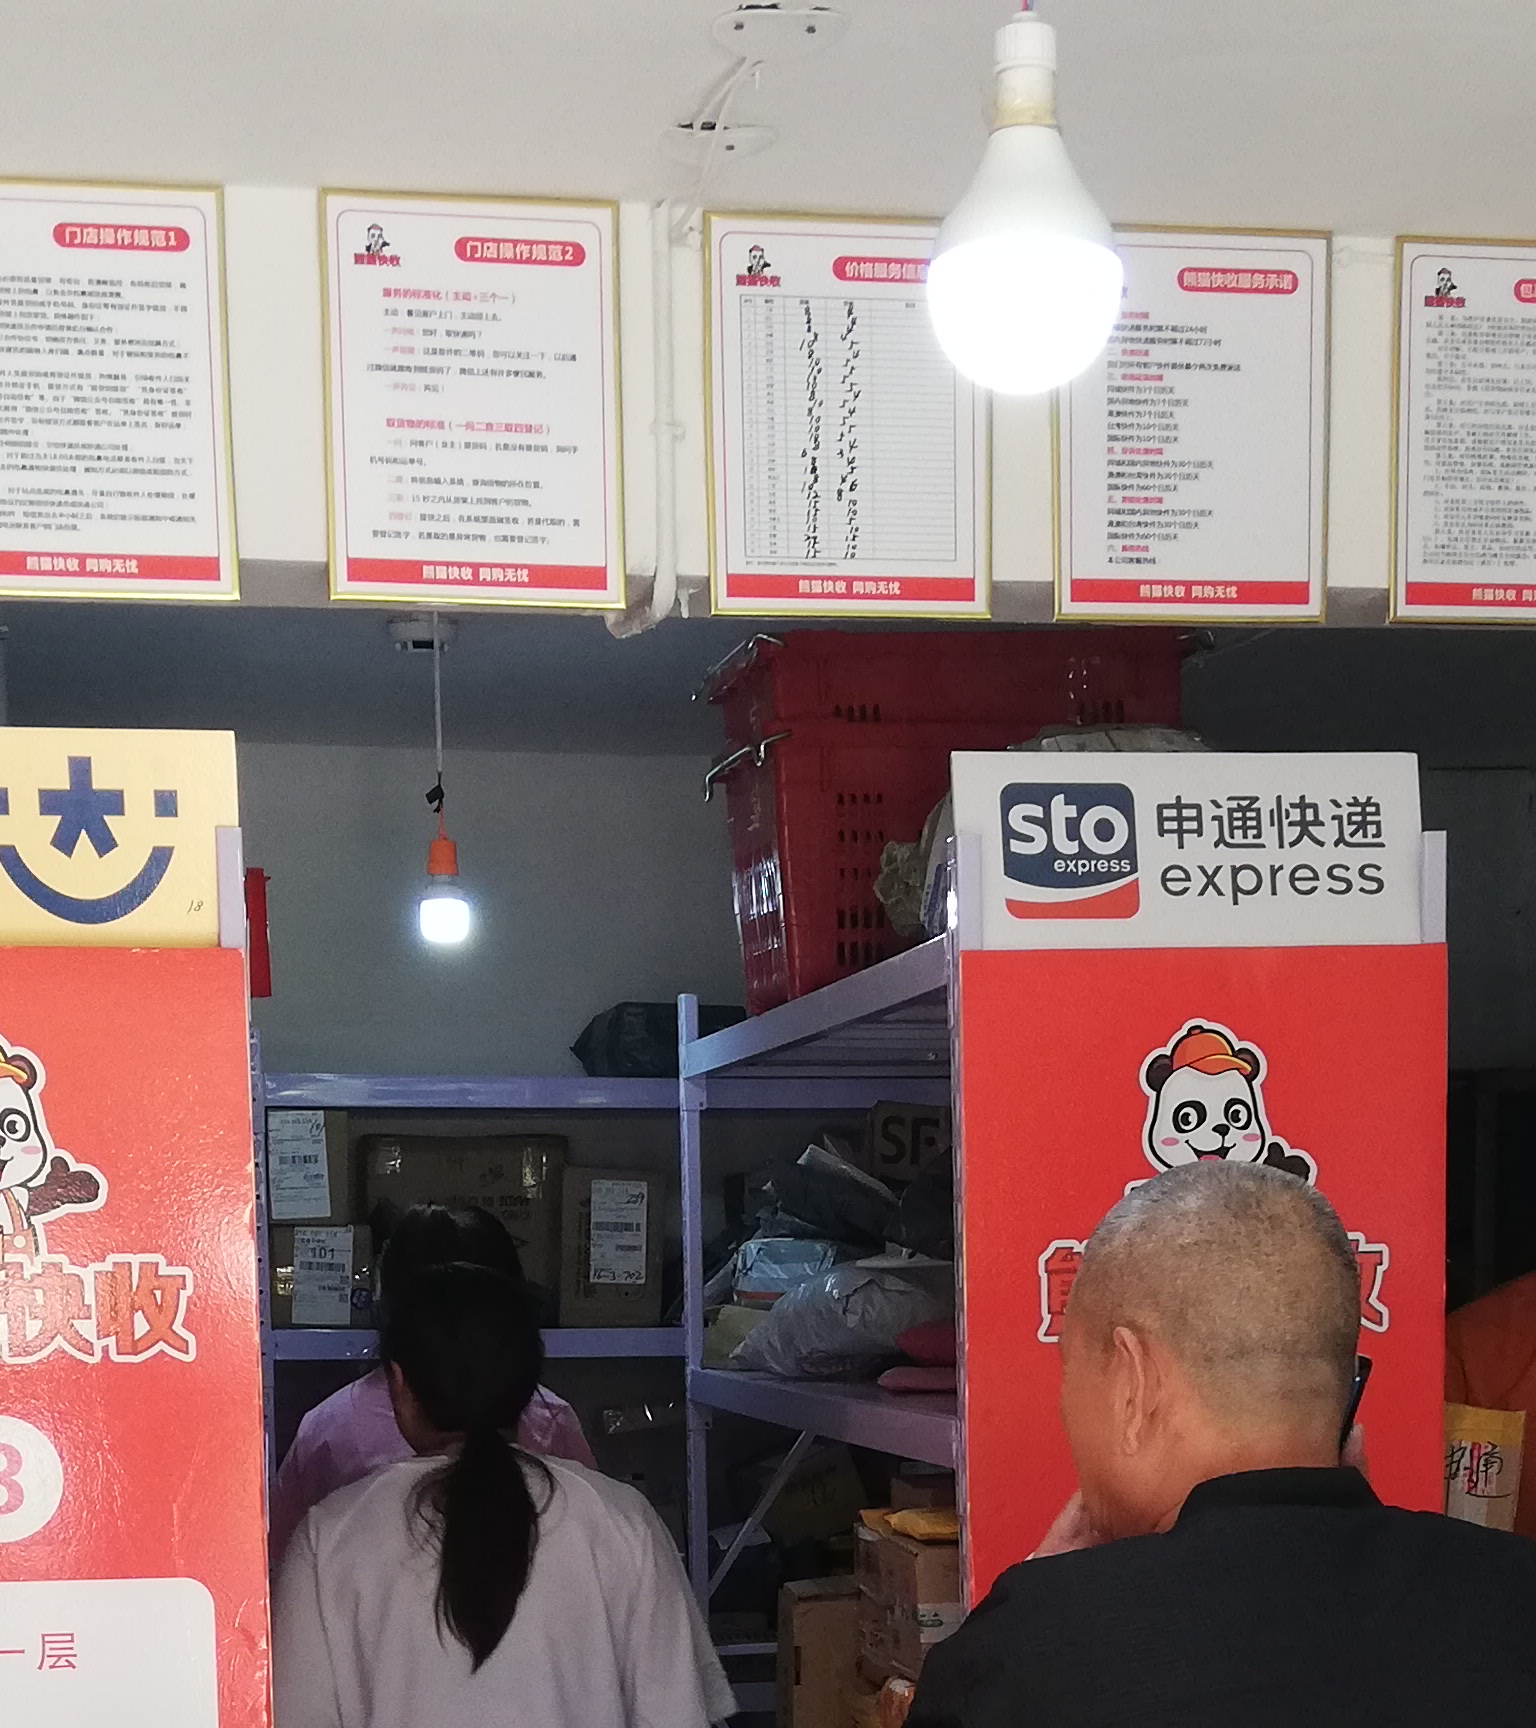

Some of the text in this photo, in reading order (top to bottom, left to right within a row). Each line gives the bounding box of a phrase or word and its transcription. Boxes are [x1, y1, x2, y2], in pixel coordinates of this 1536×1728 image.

[1006, 792, 1130, 856] sto
[1155, 794, 1387, 851] 申通快递
[1054, 857, 1132, 876] express
[1159, 862, 1385, 907] express
[880, 1115, 941, 1166] SF
